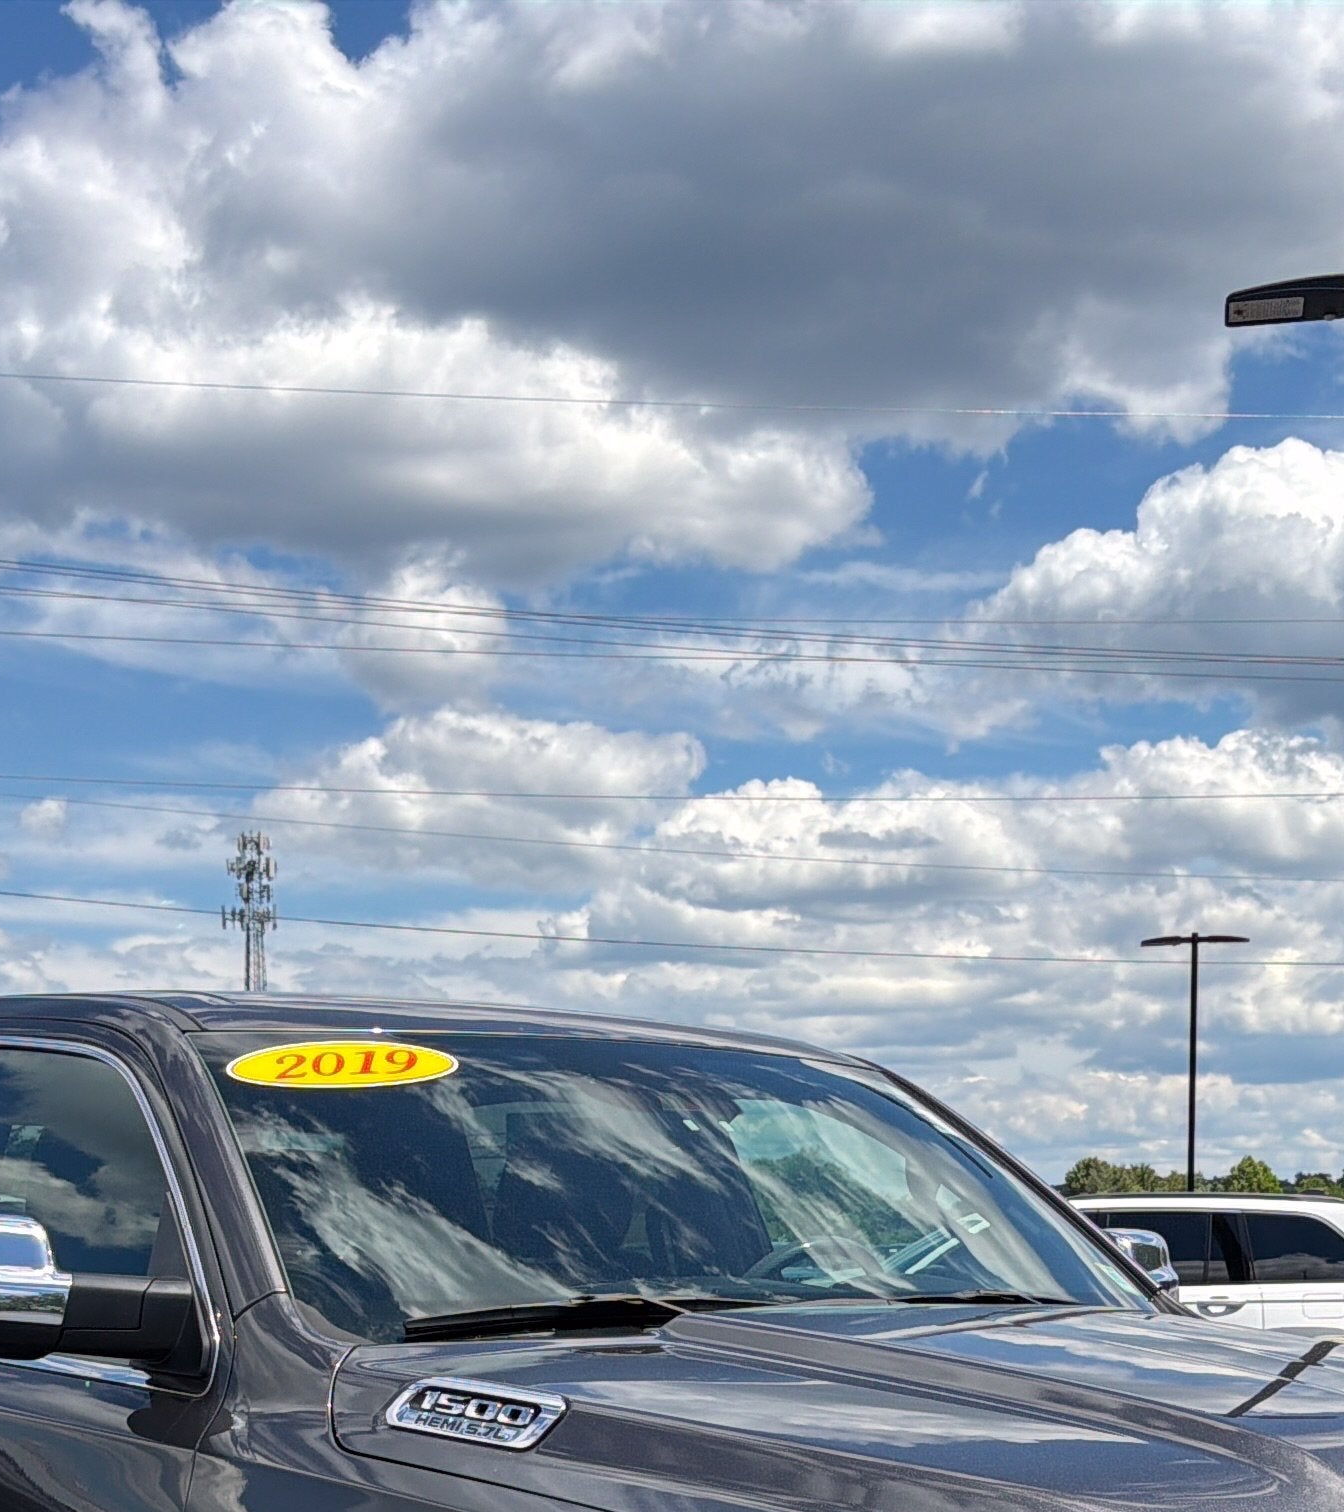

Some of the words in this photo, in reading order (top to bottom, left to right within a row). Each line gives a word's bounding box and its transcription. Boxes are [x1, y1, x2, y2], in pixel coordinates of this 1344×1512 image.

[275, 1049, 418, 1080] 2019
[419, 1390, 535, 1426] 1500
[414, 1413, 462, 1433] HEMI
[464, 1422, 510, 1441] 5.7L
